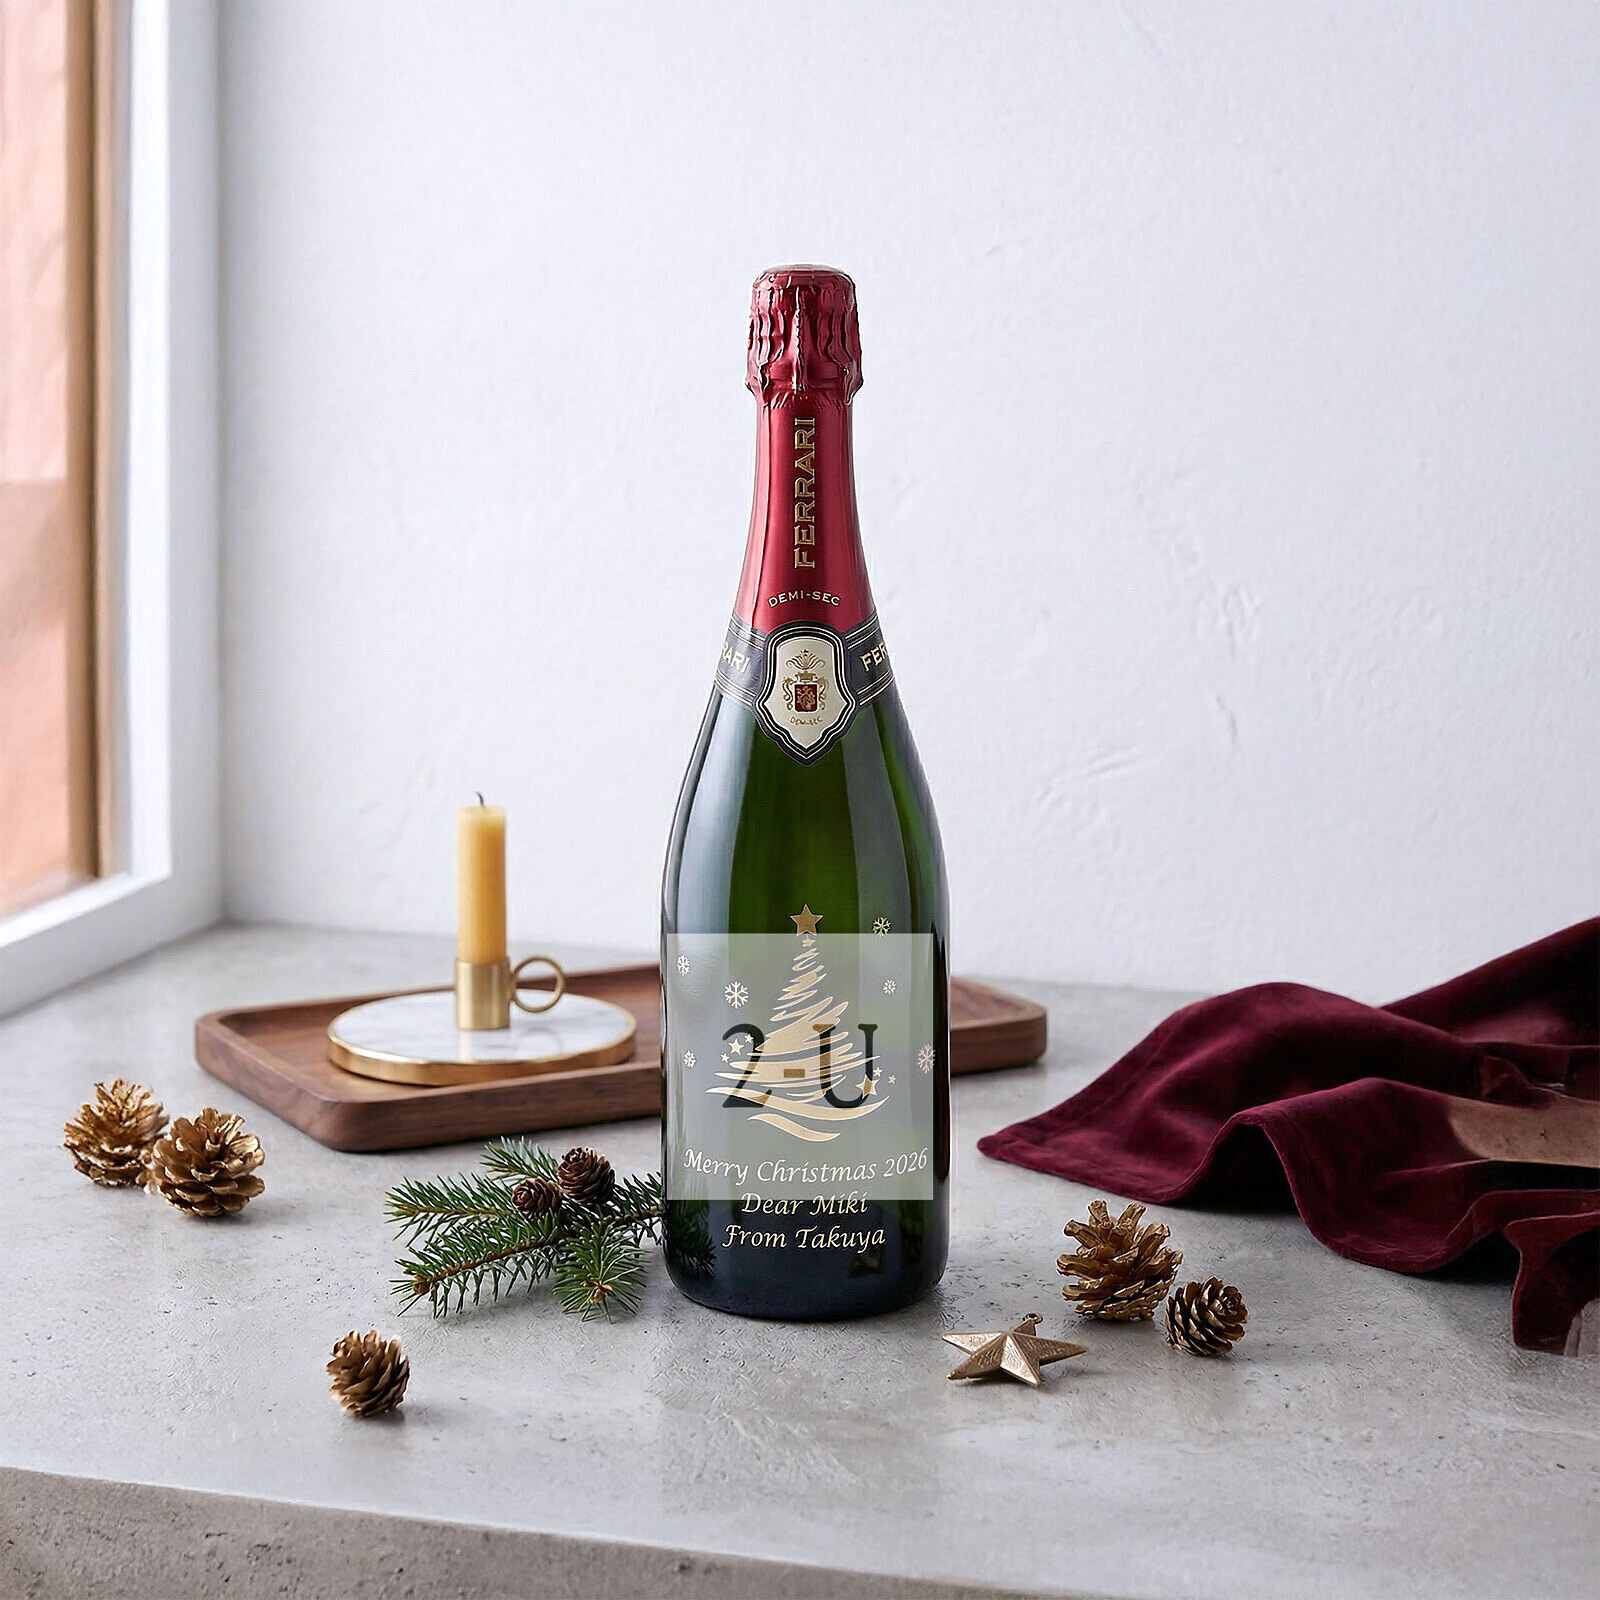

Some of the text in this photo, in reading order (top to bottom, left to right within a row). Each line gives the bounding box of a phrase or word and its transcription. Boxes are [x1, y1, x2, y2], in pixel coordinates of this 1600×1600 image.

[794, 416, 816, 569] FERRARI
[768, 590, 841, 608] DEMI-SEC
[683, 1147, 928, 1186] Merry Christmas 2026
[741, 1190, 868, 1216] Dear Miki
[721, 1224, 886, 1254] From Takuya
